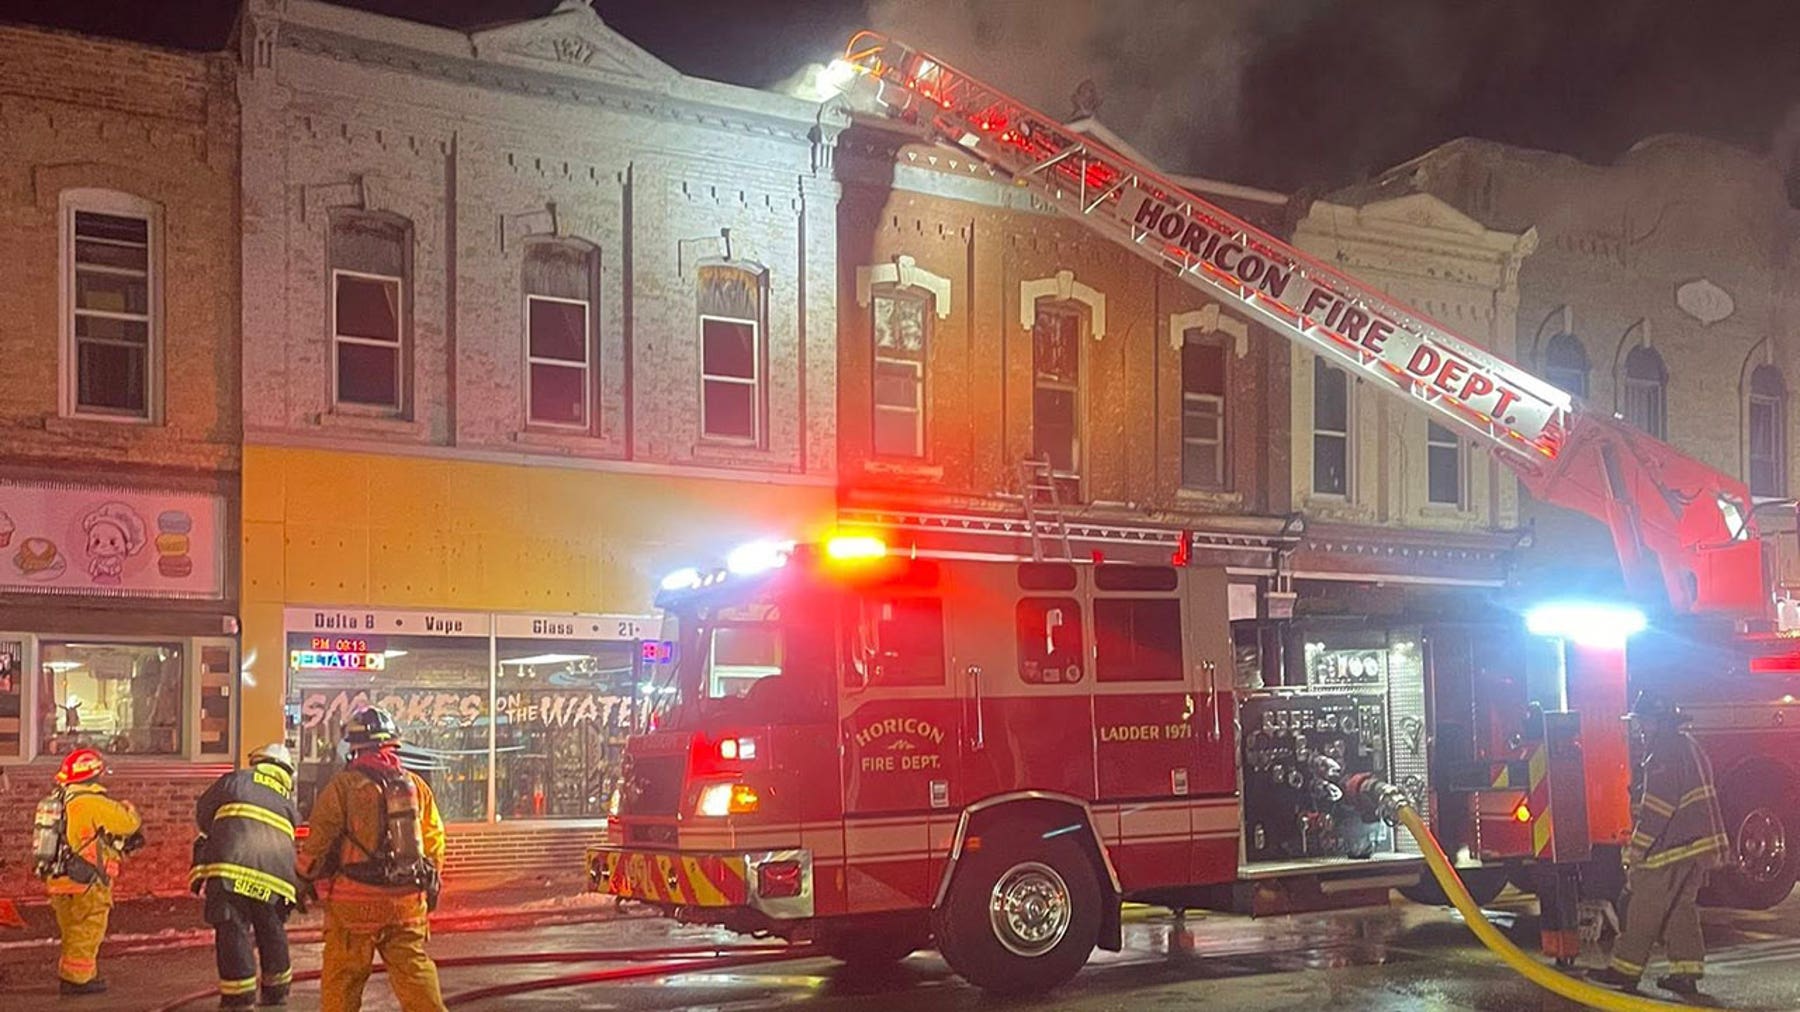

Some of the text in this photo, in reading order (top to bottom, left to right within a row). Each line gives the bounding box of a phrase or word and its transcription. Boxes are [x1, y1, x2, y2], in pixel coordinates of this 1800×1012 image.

[1134, 198, 1522, 424] HORICON FIRE DEPT.
[314, 613, 357, 629] Delta
[425, 616, 463, 633] Vape
[532, 620, 574, 635] Glass
[312, 638, 329, 650] PM
[496, 693, 521, 711] ON
[505, 706, 538, 724] THE
[856, 718, 944, 747] HORICON
[1100, 723, 1192, 741] LADDER 1971
[862, 755, 940, 771] FIRE DEPT.
